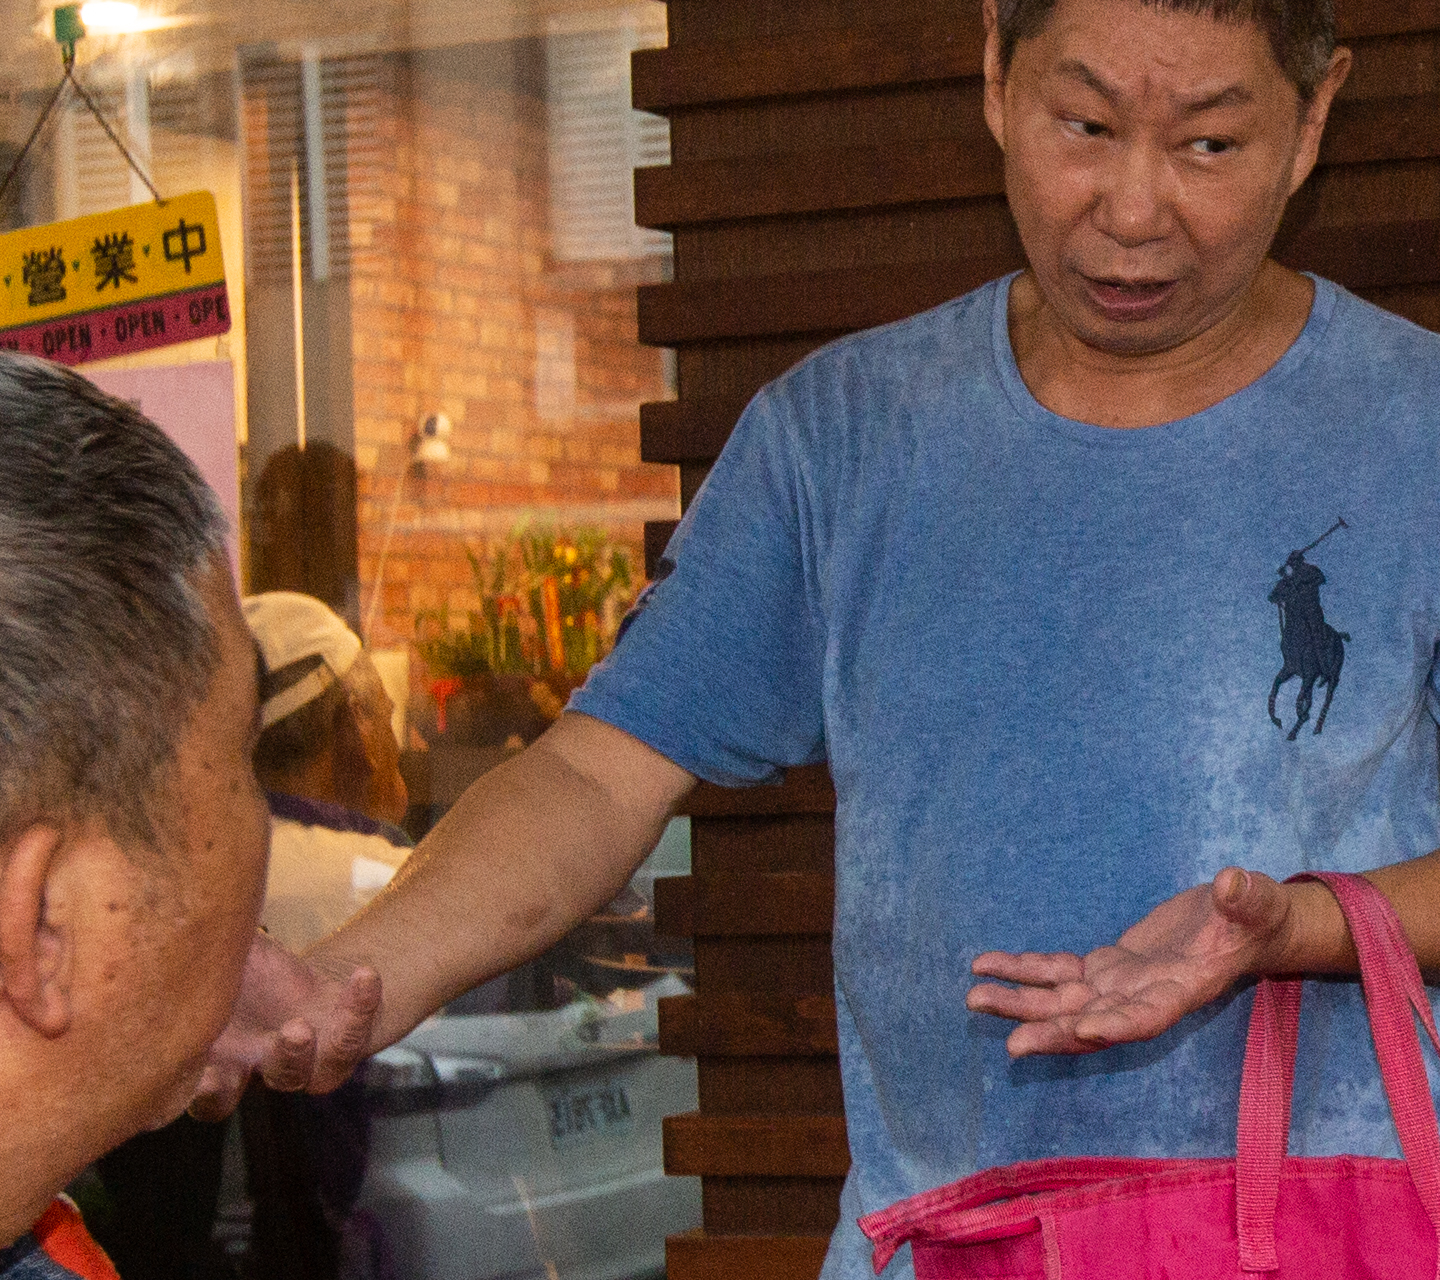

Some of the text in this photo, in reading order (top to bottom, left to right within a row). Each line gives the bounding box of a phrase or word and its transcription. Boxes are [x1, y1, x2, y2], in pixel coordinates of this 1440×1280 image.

[22, 219, 208, 307] 營業中
[42, 322, 92, 357] OPEN
[114, 308, 166, 342] OPEN
